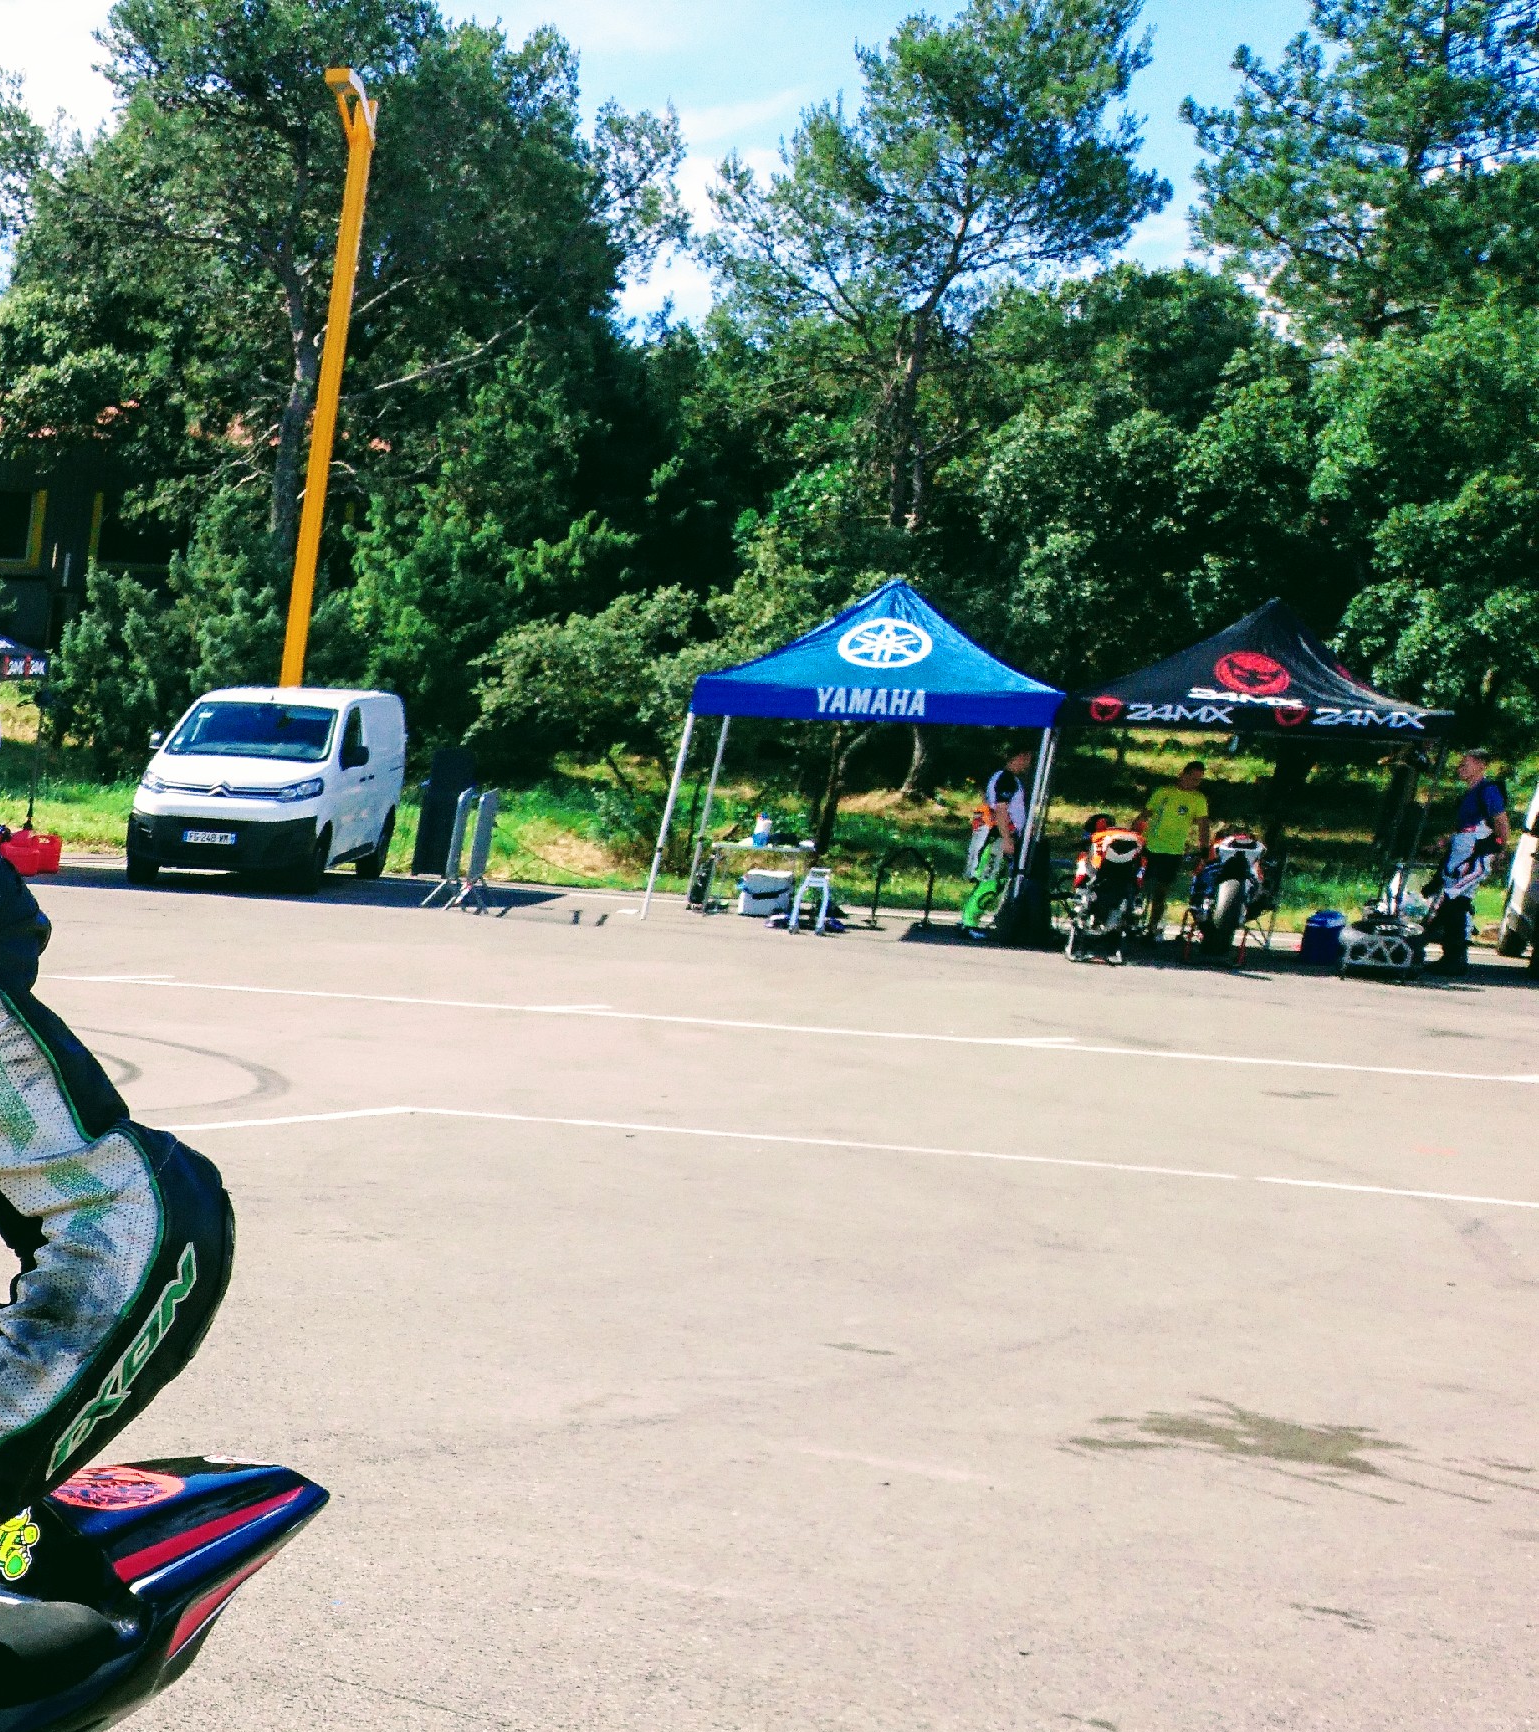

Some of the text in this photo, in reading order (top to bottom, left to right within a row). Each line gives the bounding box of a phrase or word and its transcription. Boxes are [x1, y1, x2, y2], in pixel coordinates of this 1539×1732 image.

[817, 687, 926, 717] YAMAHA
[1126, 703, 1425, 730] 24MX 24MX
